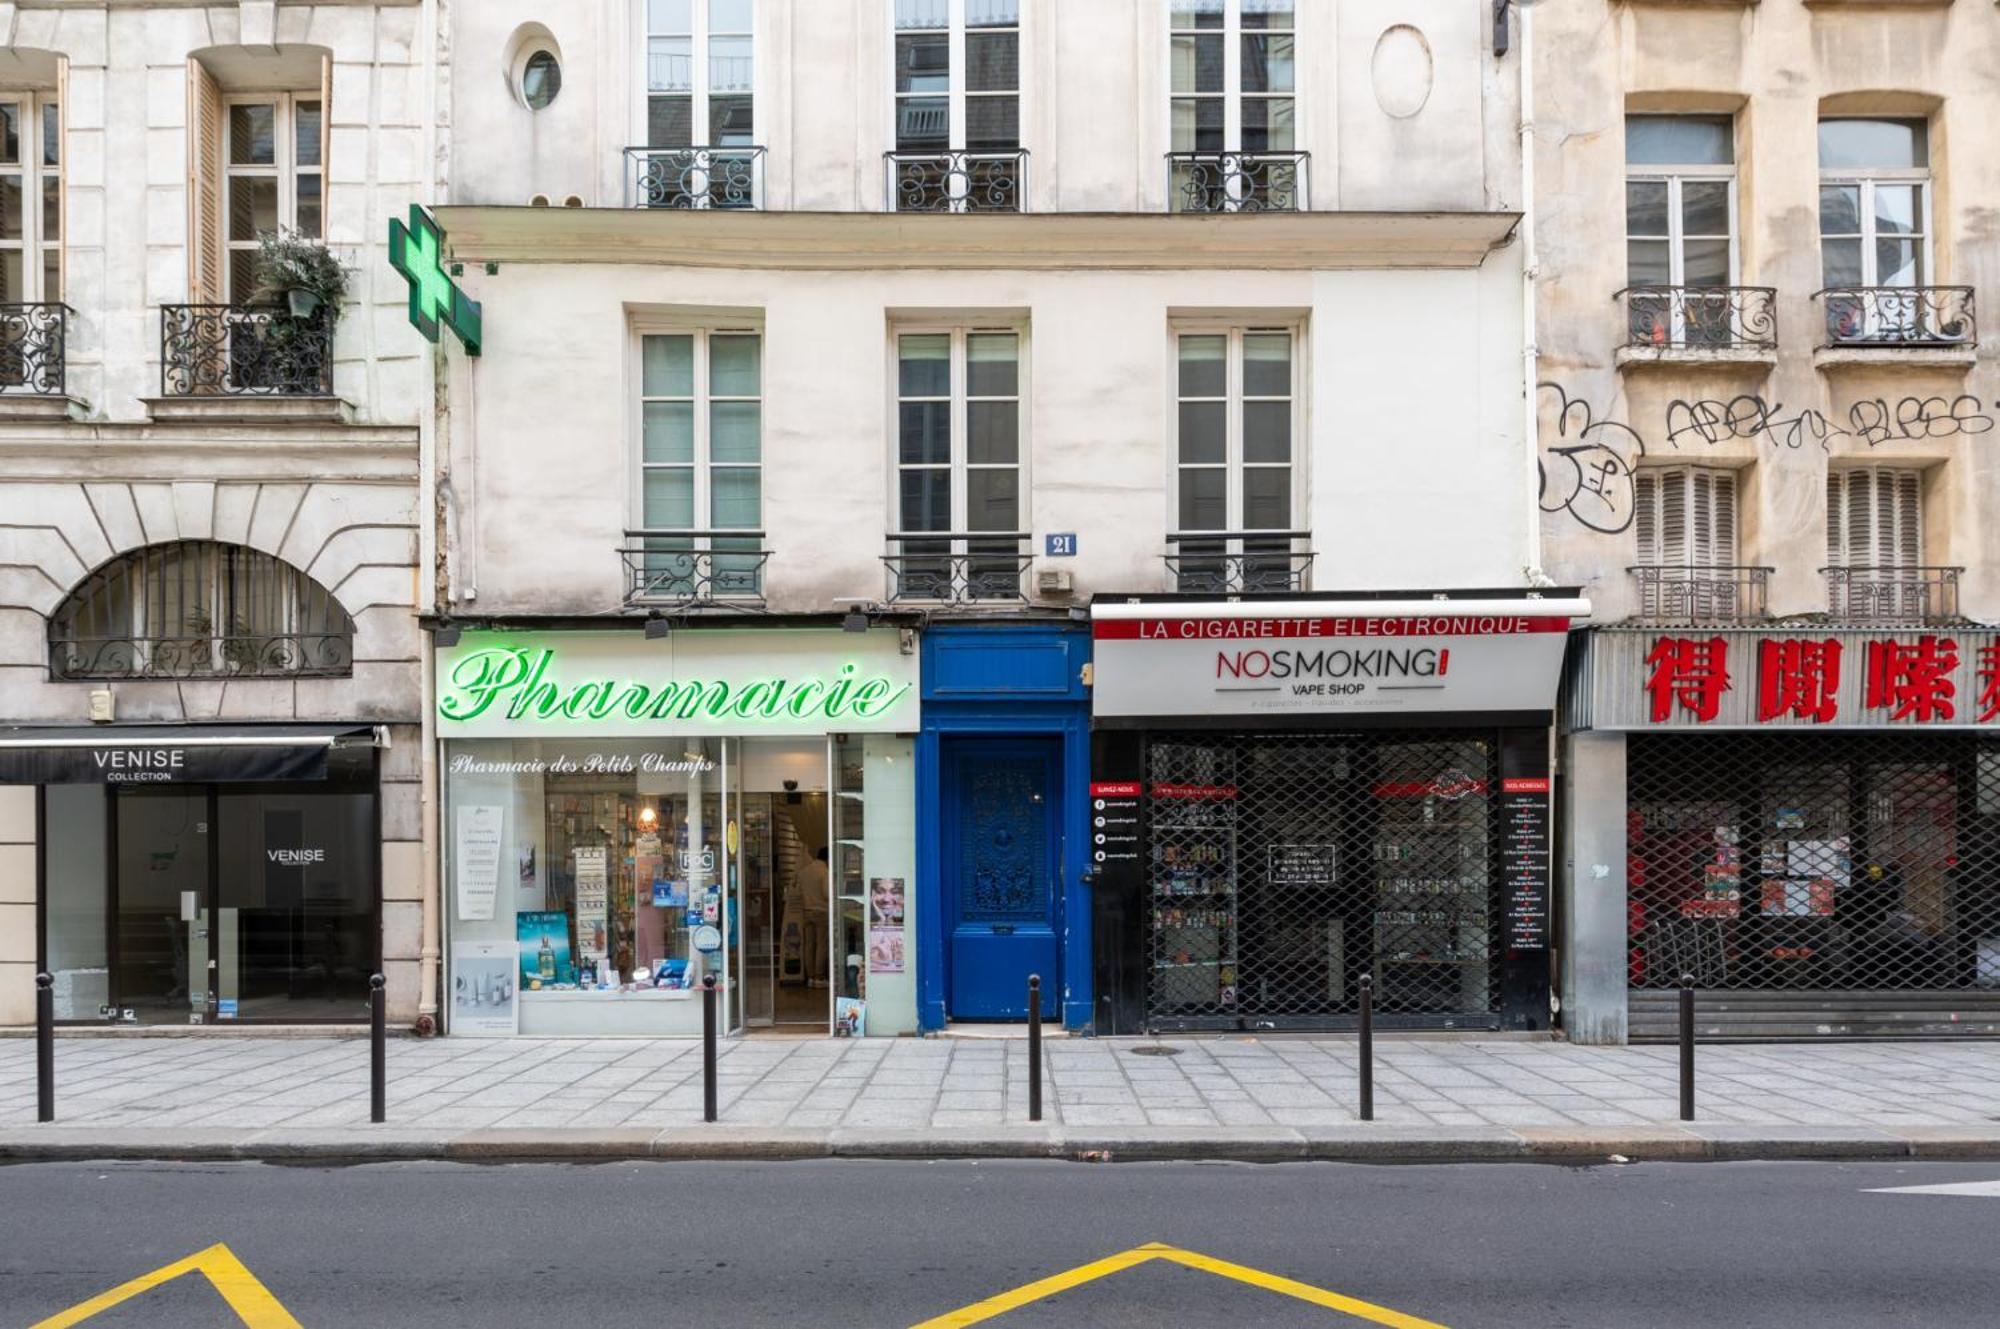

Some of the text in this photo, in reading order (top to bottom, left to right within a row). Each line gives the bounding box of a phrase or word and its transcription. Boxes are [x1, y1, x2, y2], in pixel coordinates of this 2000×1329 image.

[1052, 536, 1071, 553] 21
[1140, 617, 1530, 638] LA CIGARETTE ELECTRONIQUE
[439, 647, 912, 722] Pharmacie
[1292, 684, 1365, 695] VAPE SHOP
[94, 750, 184, 768] VENISE
[450, 752, 714, 778] Pharmacie des Petits Champs
[107, 772, 172, 781] COLLECTION
[267, 849, 325, 861] VENISE
